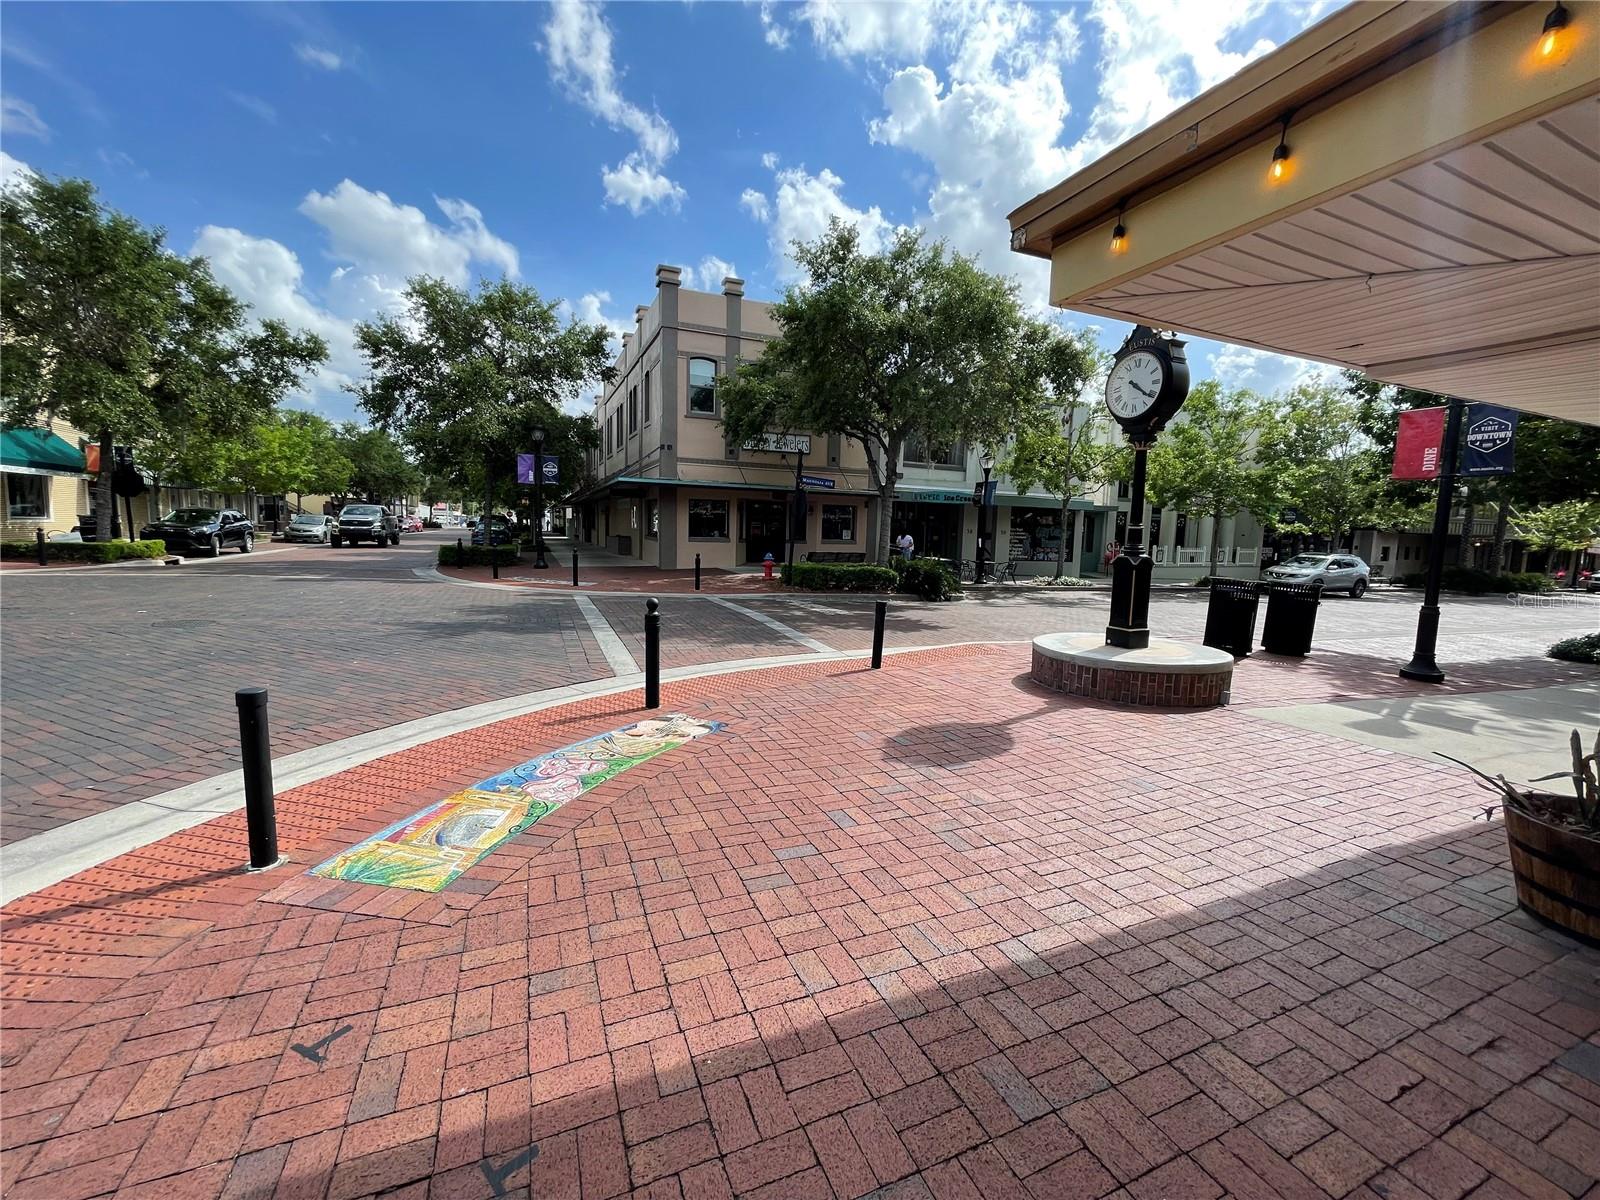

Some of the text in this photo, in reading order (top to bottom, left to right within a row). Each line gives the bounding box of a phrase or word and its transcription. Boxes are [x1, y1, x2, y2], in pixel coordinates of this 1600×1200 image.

[1129, 338, 1156, 351] EUSTIS
[1467, 431, 1512, 441] DOWNTOWN
[1422, 447, 1437, 471] DINE
